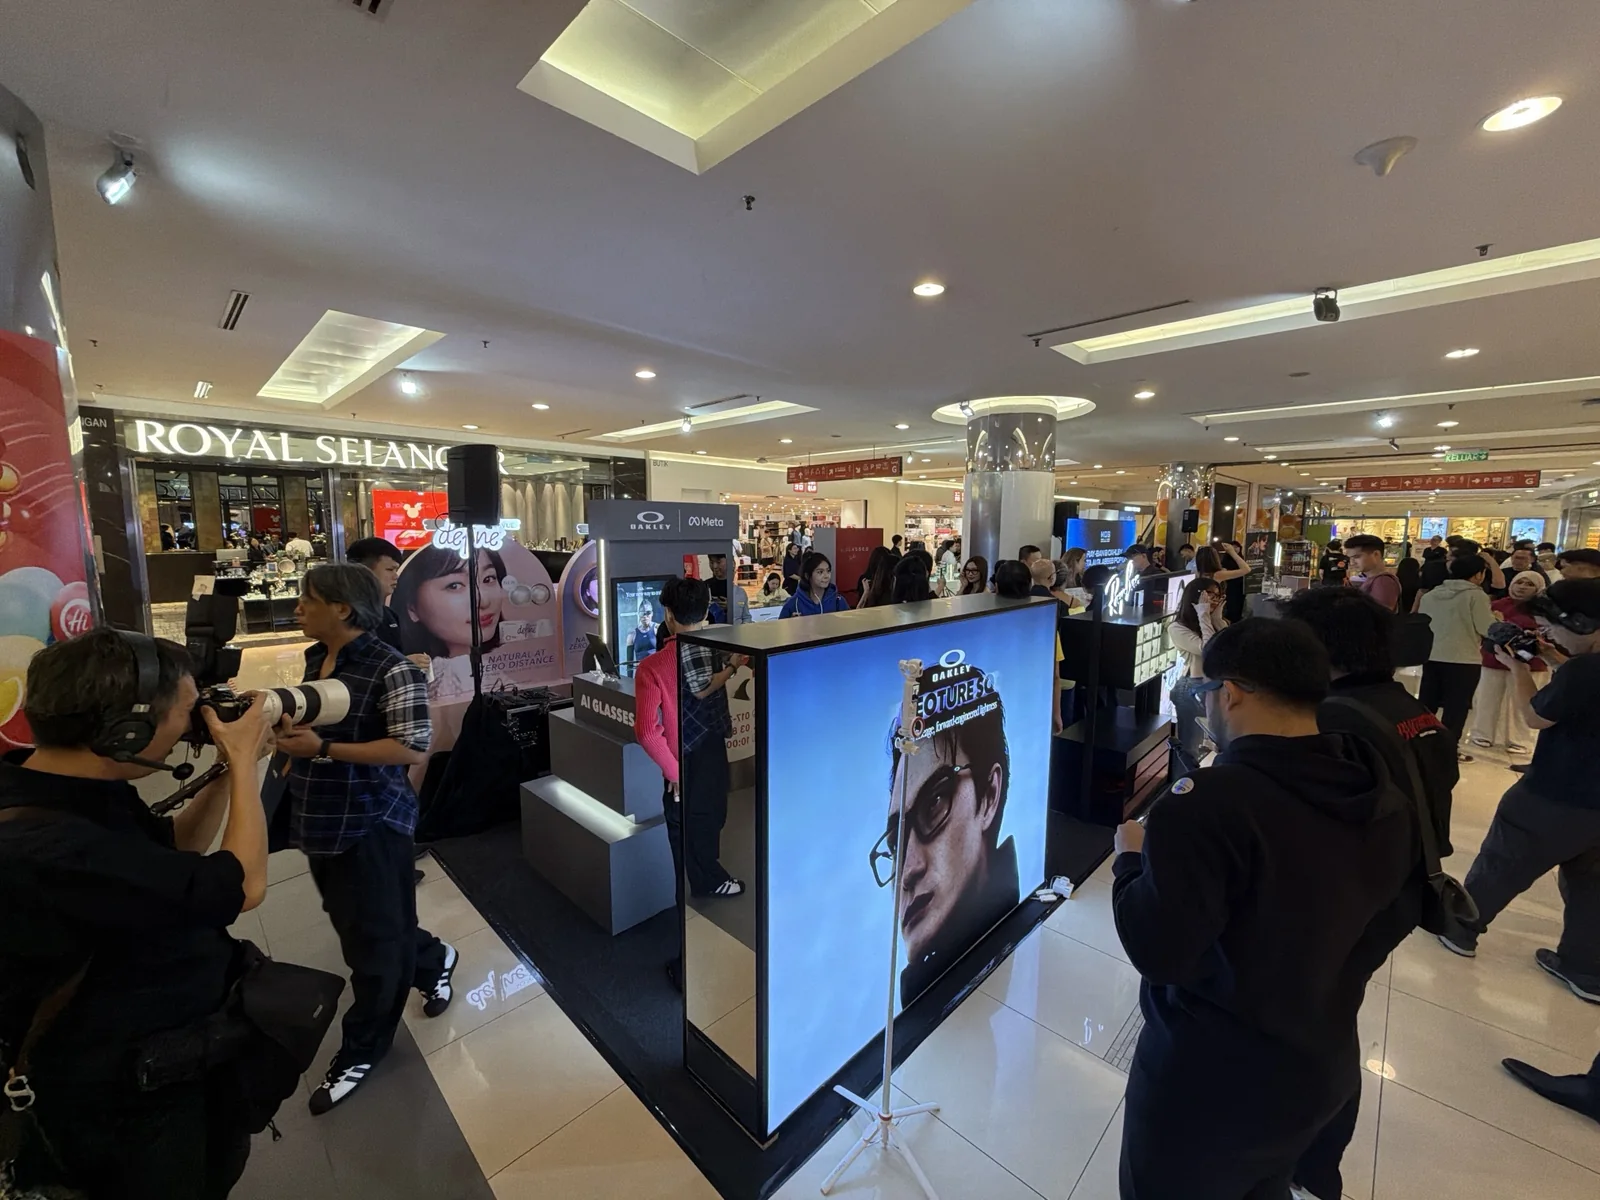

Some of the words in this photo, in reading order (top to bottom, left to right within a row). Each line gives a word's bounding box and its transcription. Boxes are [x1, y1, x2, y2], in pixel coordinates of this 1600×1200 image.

[135, 420, 303, 462] ROYAL
[701, 517, 724, 527] Meta
[69, 610, 88, 632] Hi
[488, 651, 532, 664] NATURAL
[535, 648, 546, 657] AT
[508, 655, 555, 669] DISTANCE
[932, 664, 972, 682] OAKLEY
[580, 694, 591, 709] AI
[592, 700, 635, 727] GLASSES
